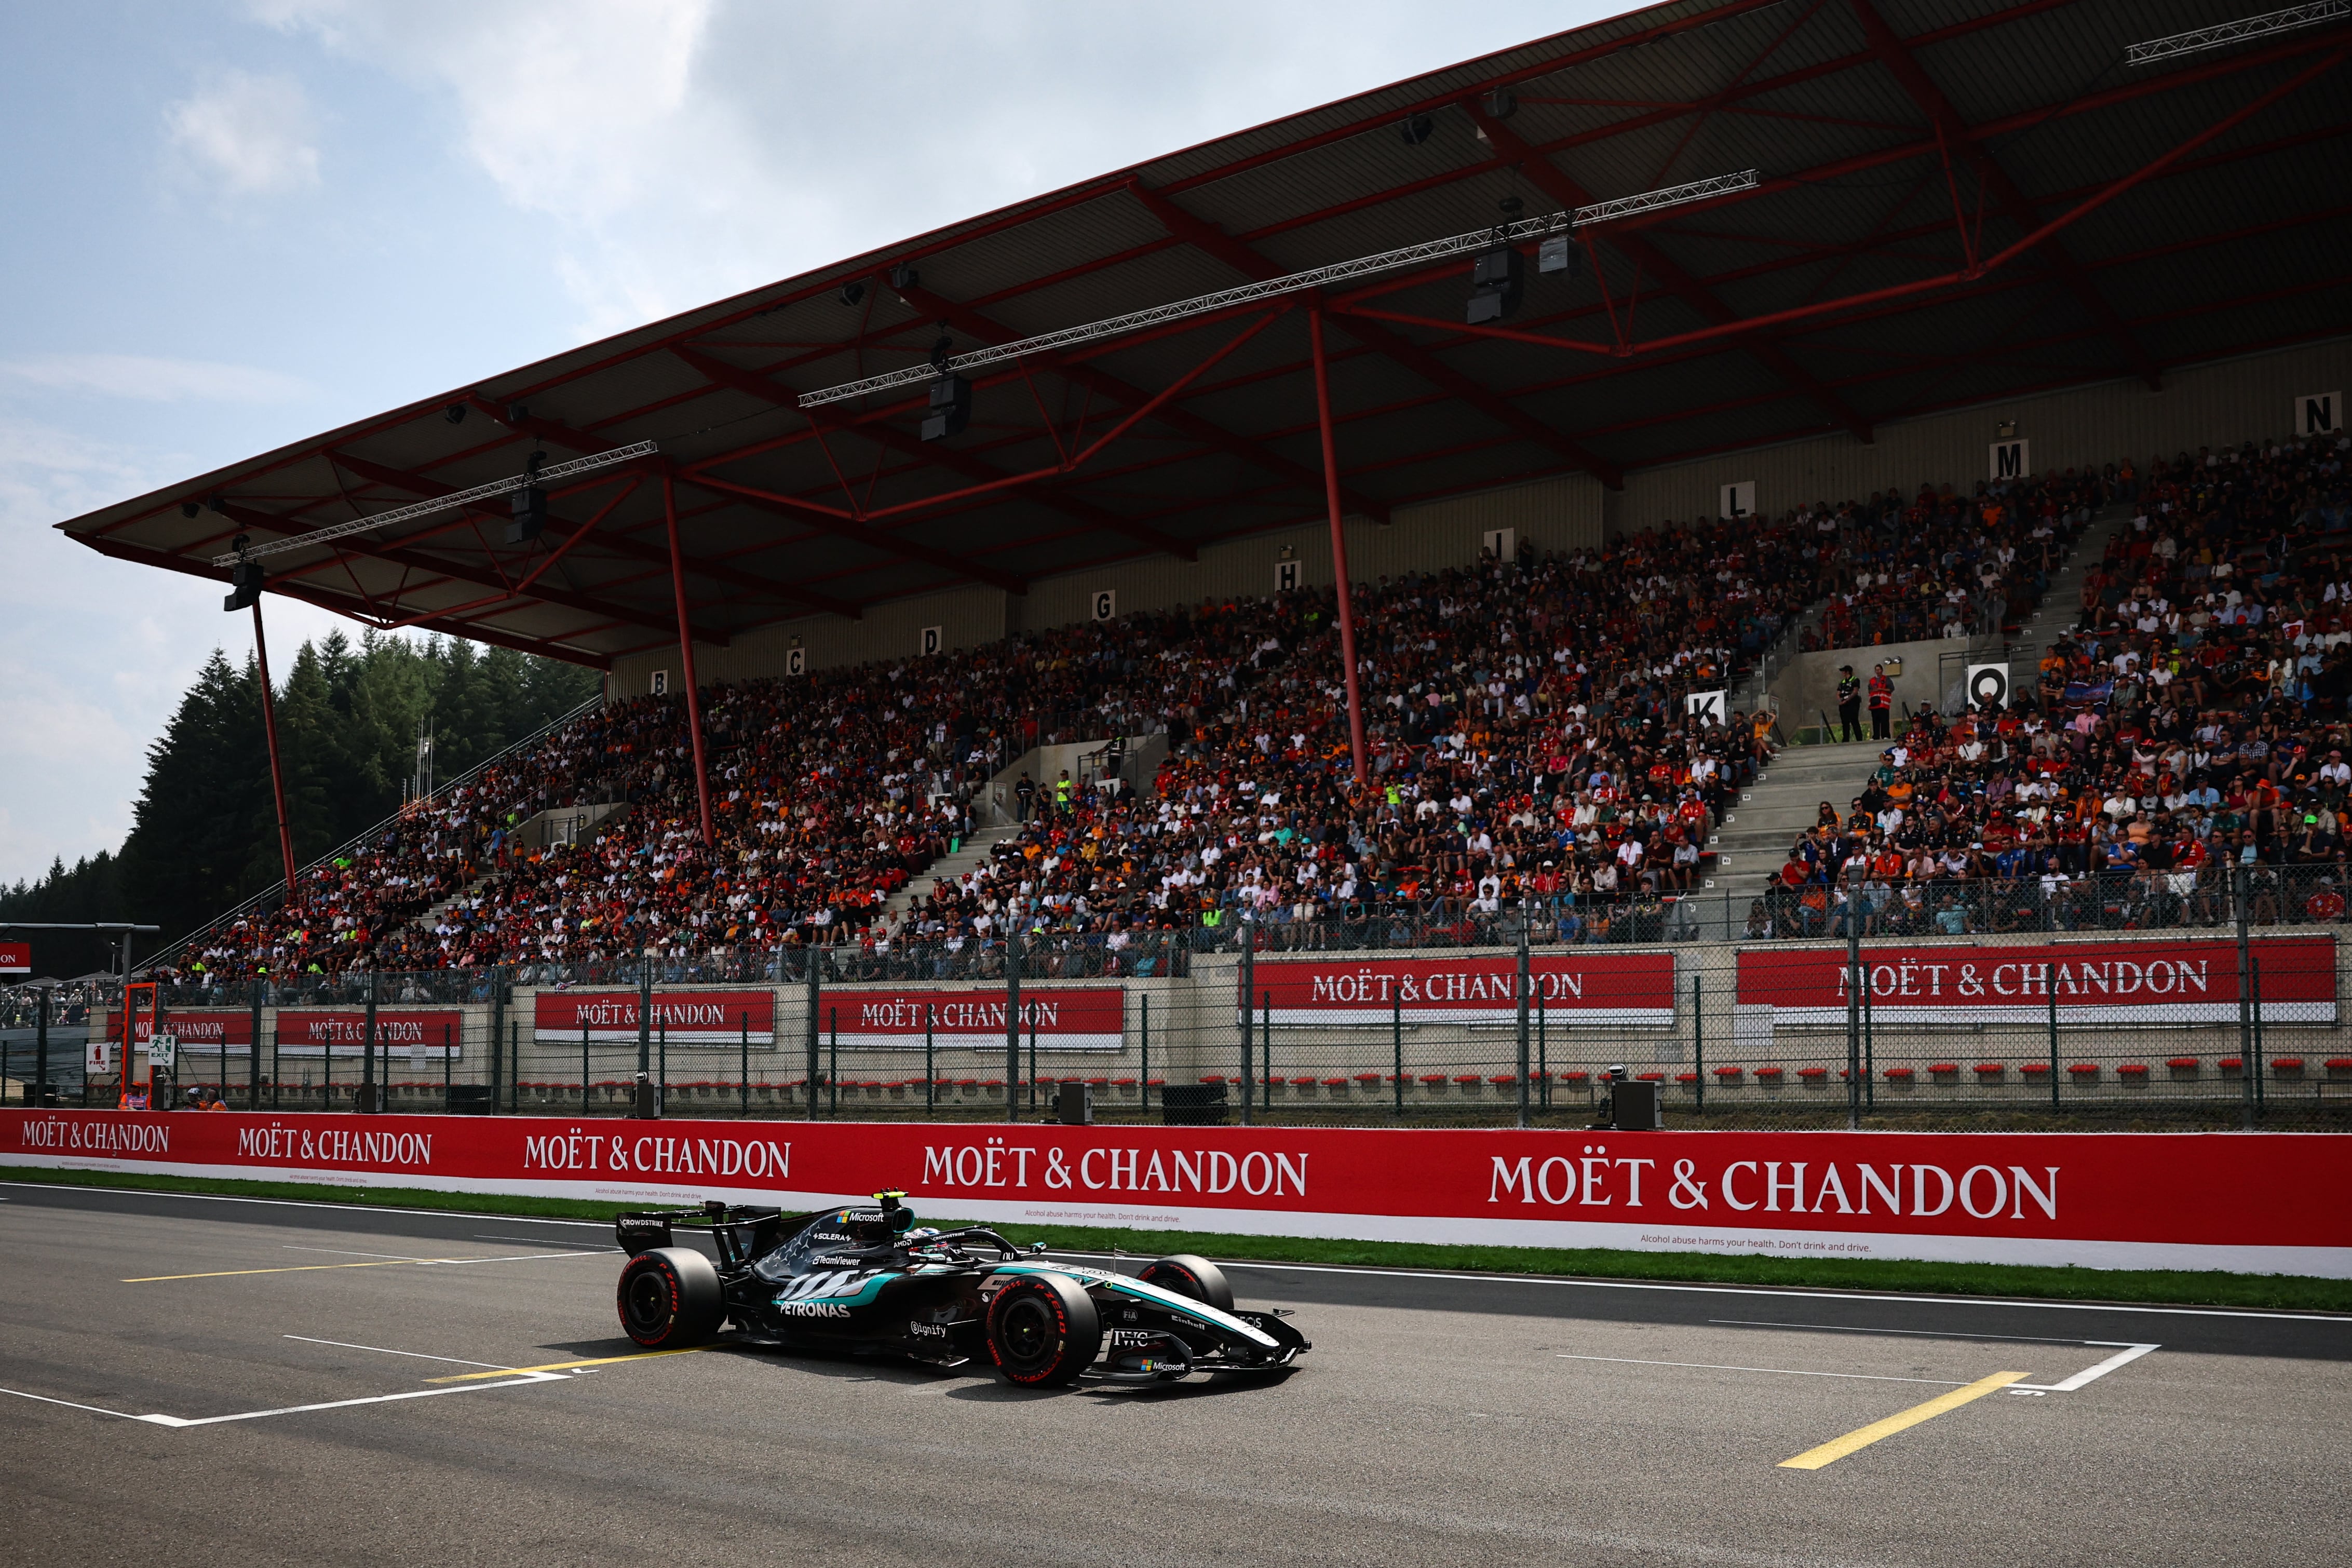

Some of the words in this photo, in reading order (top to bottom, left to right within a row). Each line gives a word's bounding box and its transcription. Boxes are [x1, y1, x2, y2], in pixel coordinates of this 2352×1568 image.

[2306, 397, 2332, 431] N
[1997, 445, 2022, 475] M
[1730, 487, 1746, 516] L
[1496, 532, 1502, 559] I
[1281, 563, 1295, 590] H
[1097, 593, 1110, 619] G
[925, 630, 937, 654] D
[790, 651, 801, 673] C
[655, 673, 664, 694] B
[1693, 696, 1718, 727] K
[1311, 968, 1395, 1002] MOËT
[1400, 974, 1420, 1001] &
[1957, 963, 1985, 996] &
[1992, 960, 2209, 996] CHANDON
[576, 999, 621, 1025] MOËT
[625, 1004, 635, 1025] &
[639, 1004, 725, 1025] HANDON
[861, 998, 921, 1026] MOËT
[308, 1018, 344, 1040] MOËT
[345, 1022, 354, 1040] &
[356, 1022, 423, 1040] CANDON
[22, 1115, 67, 1146] MOËT
[70, 1122, 80, 1148] &
[84, 1123, 169, 1152] CHANDON
[238, 1122, 296, 1157] MOËT
[301, 1130, 314, 1159] &
[319, 1131, 431, 1164] CHANDON
[524, 1128, 603, 1169] MOËT
[610, 1136, 628, 1170] &
[634, 1138, 791, 1178] CHANDON
[922, 1138, 1036, 1186] MOËT
[1045, 1147, 1071, 1188] &
[1081, 1149, 1308, 1196] CHANDON
[1488, 1145, 1655, 1206] MOËT
[1669, 1159, 1708, 1210] &
[1722, 1161, 2060, 1219] CHANDON
[623, 1219, 664, 1227] CROWDSTRIKE
[849, 1212, 884, 1222] Microsoft
[932, 1232, 965, 1241] CROWDSTRIKE
[1641, 1234, 1670, 1243] Alcohol
[1672, 1235, 1696, 1245] abuse
[1699, 1236, 1724, 1246] harms
[1727, 1239, 1746, 1249] your
[1748, 1239, 1776, 1248] health.
[1779, 1240, 1802, 1249] Don't
[1804, 1241, 1826, 1250] drink
[1828, 1242, 1845, 1251] and
[1847, 1242, 1871, 1252] drive.
[819, 1255, 860, 1266] TeamViewer
[780, 1301, 851, 1318] PETRONAS
[1044, 1291, 1066, 1333] ZERO
[1123, 1311, 1137, 1320] FIA
[1171, 1315, 1205, 1331] Einhell
[1114, 1331, 1148, 1347] IWC
[1153, 1362, 1186, 1371] Microsoft
